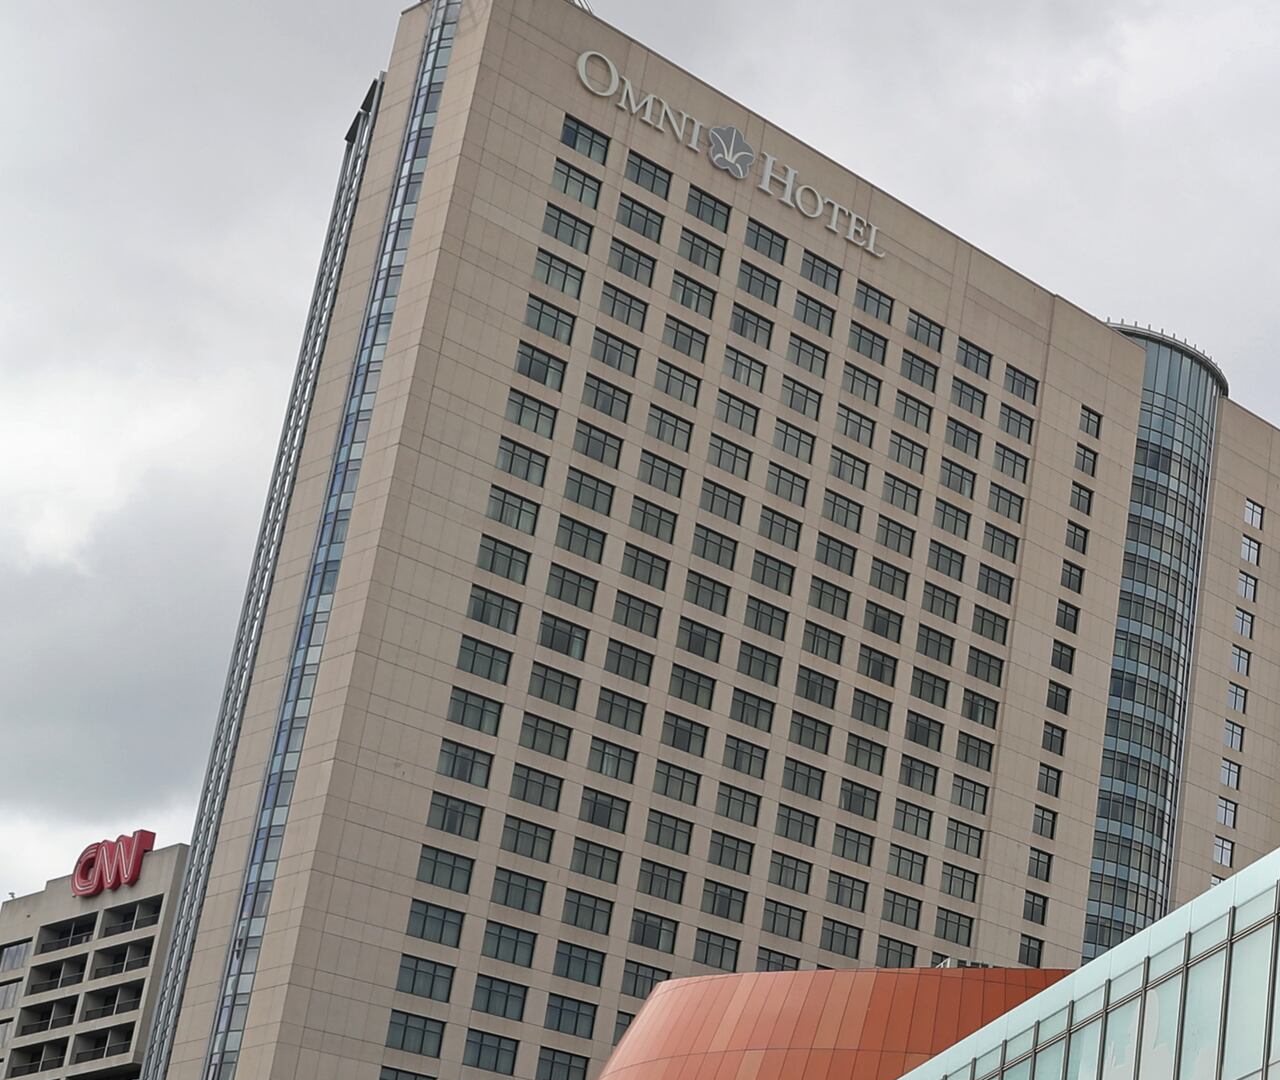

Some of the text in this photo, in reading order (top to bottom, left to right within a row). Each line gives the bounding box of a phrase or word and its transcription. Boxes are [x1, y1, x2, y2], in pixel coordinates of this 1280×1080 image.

[576, 50, 886, 259] OMNI HOTEL
[71, 830, 155, 896] CNN
